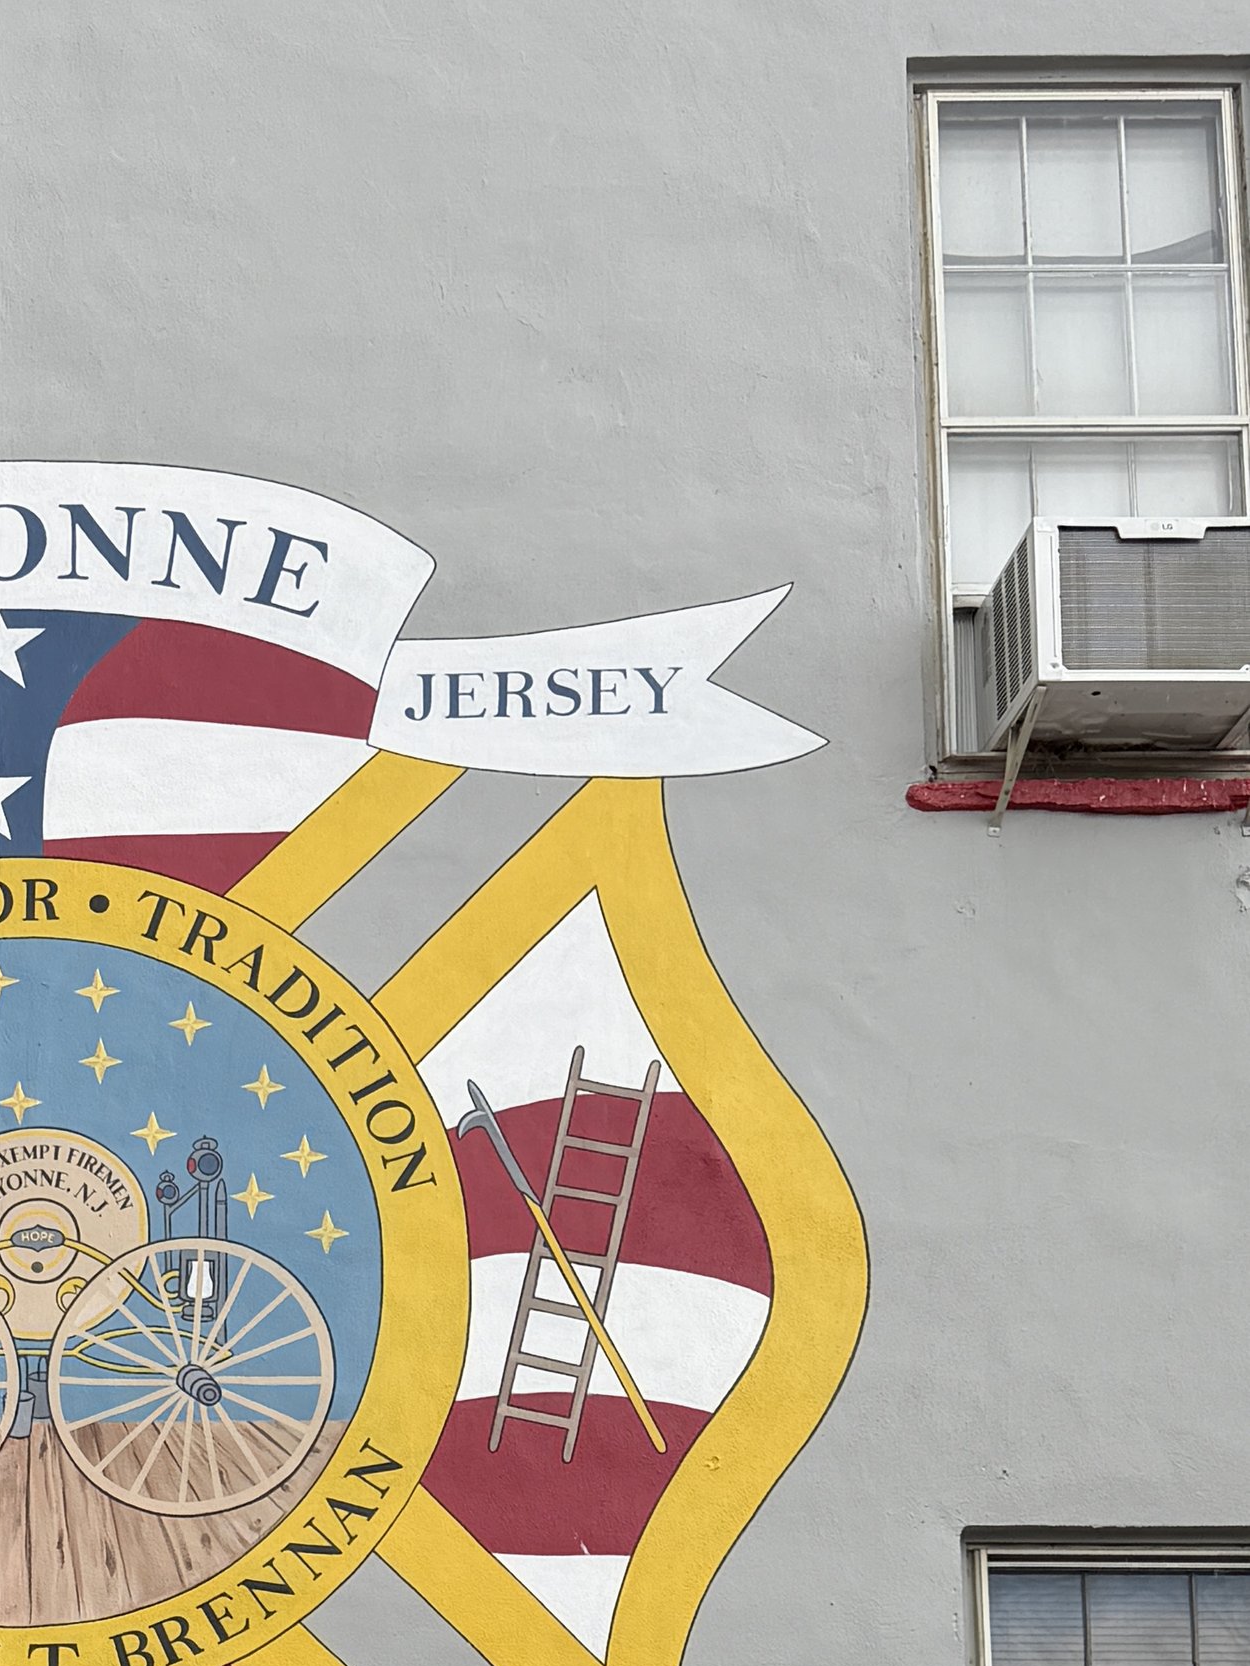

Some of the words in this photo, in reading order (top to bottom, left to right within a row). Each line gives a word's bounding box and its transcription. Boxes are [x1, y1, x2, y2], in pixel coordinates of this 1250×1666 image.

[404, 666, 683, 721] JERSEY
[137, 890, 438, 1194] TRADITION
[66, 1147, 134, 1211] FIREMEN
[73, 1182, 109, 1218] N.J.
[20, 1231, 56, 1244] HOPE
